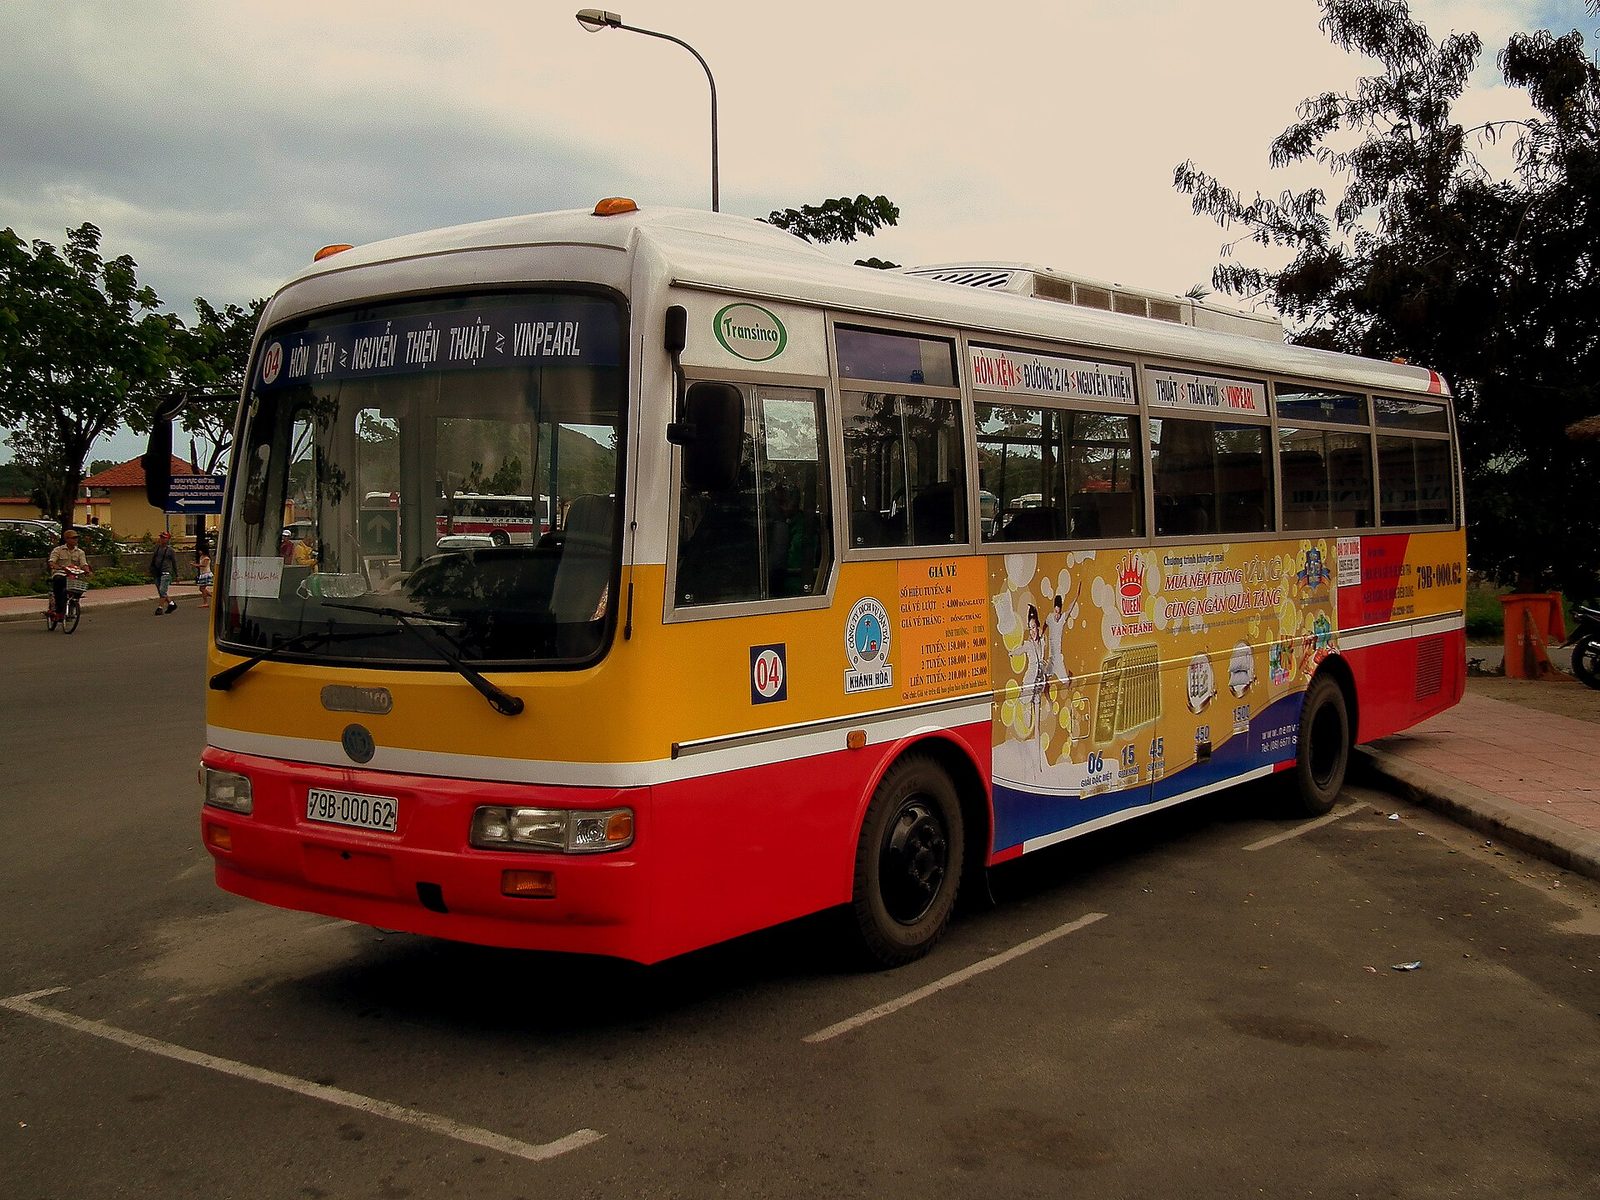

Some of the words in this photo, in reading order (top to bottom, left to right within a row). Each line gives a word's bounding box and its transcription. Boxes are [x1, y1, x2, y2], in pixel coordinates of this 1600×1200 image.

[724, 317, 778, 342] Transinco
[263, 348, 280, 380] 04
[289, 338, 308, 378] HÒN
[314, 335, 334, 380] XỆN
[351, 320, 398, 370] NGUYỄN
[405, 321, 440, 369] THIỆN
[448, 316, 491, 366] THUẬT
[513, 321, 581, 357] VINPEARL
[973, 350, 995, 385] HÒN
[995, 353, 1015, 391] XỆN
[1023, 358, 1053, 391] ĐƯỜNG
[1054, 368, 1070, 392] 2/4
[1076, 364, 1108, 396] NGUYỄN
[1108, 371, 1132, 402] THIỆN
[1156, 376, 1178, 406] THUẬT
[1187, 377, 1206, 405] TRẦN
[1206, 381, 1219, 406] PHÚ
[1226, 385, 1256, 410] VINPEARL
[928, 563, 943, 578] GIÁ
[946, 562, 957, 577] VÉ
[1165, 574, 1189, 590] MUA
[1211, 568, 1243, 586] TRÚNG
[1164, 597, 1196, 620] CÙNG
[1196, 594, 1228, 615] NGÀN
[1228, 587, 1251, 613] QUÀ
[1253, 586, 1282, 610] TẶNG
[757, 656, 779, 691] 04
[849, 672, 873, 689] KHÁNH
[875, 670, 889, 686] HÒA
[1088, 750, 1104, 774] 06
[1121, 744, 1135, 767] 15
[310, 793, 394, 828] 79B-000.62
